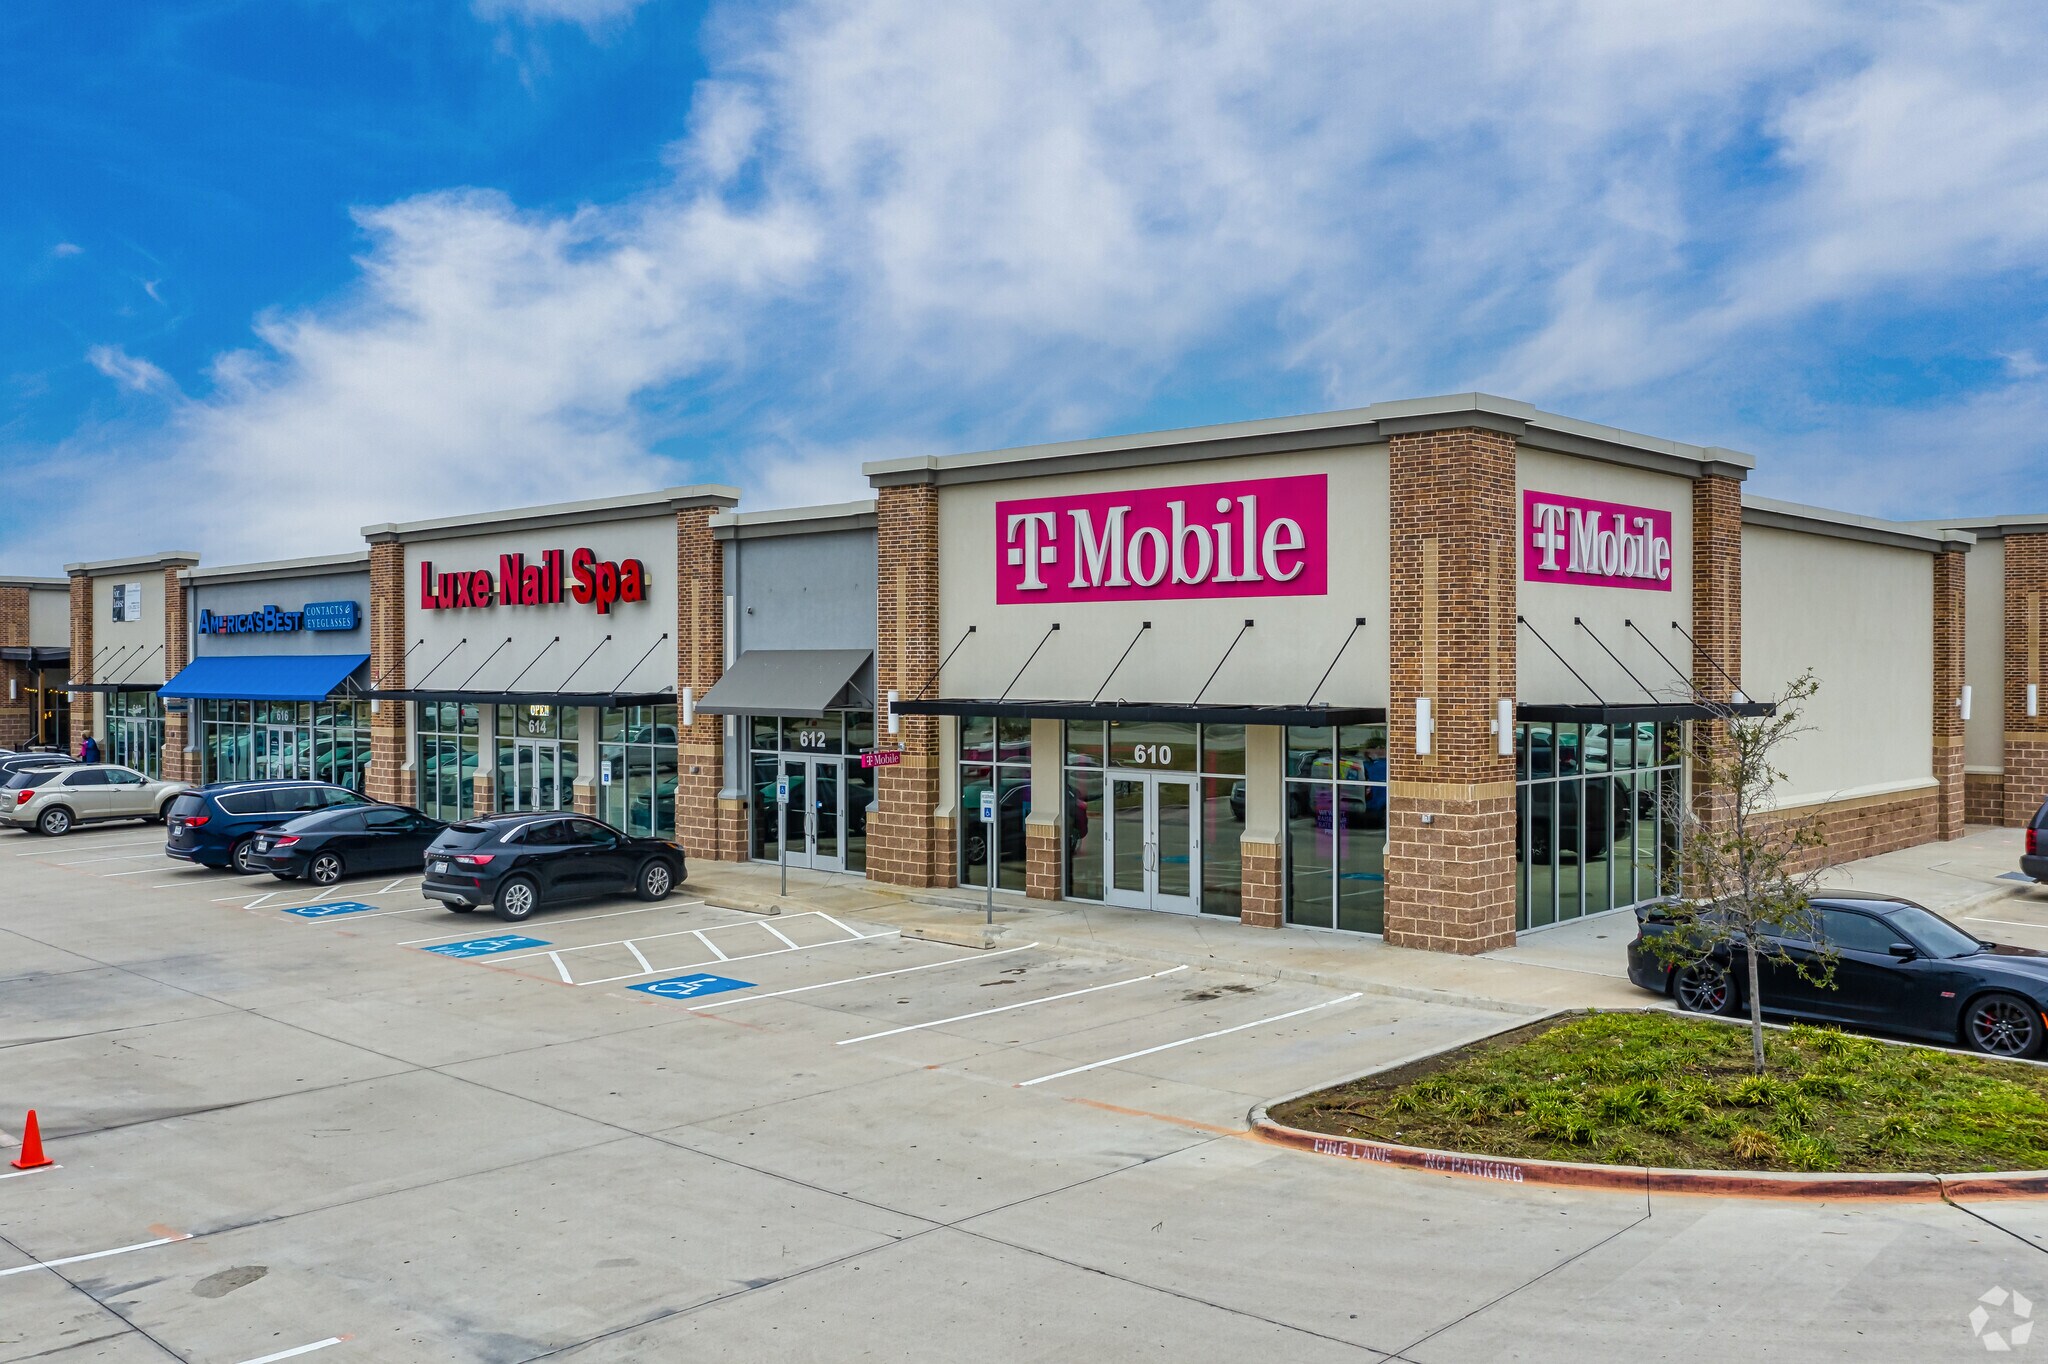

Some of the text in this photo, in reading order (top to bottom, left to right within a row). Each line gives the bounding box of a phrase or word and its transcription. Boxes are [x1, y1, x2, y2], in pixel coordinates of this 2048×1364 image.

[1067, 495, 1305, 587] Mobile
[1566, 507, 1670, 581] Mobile
[421, 547, 647, 615] Luxe Nail Spa
[306, 604, 351, 616] CONTACTS &
[307, 618, 351, 628] EYEGLASSES
[276, 710, 289, 722] 616
[530, 705, 550, 716] OPEN
[528, 719, 547, 734] 614
[800, 731, 826, 748] 612
[874, 752, 899, 766] Mobile
[1134, 744, 1172, 765] 610
[1314, 1139, 1524, 1183] FIRE LANE NO PARKING
